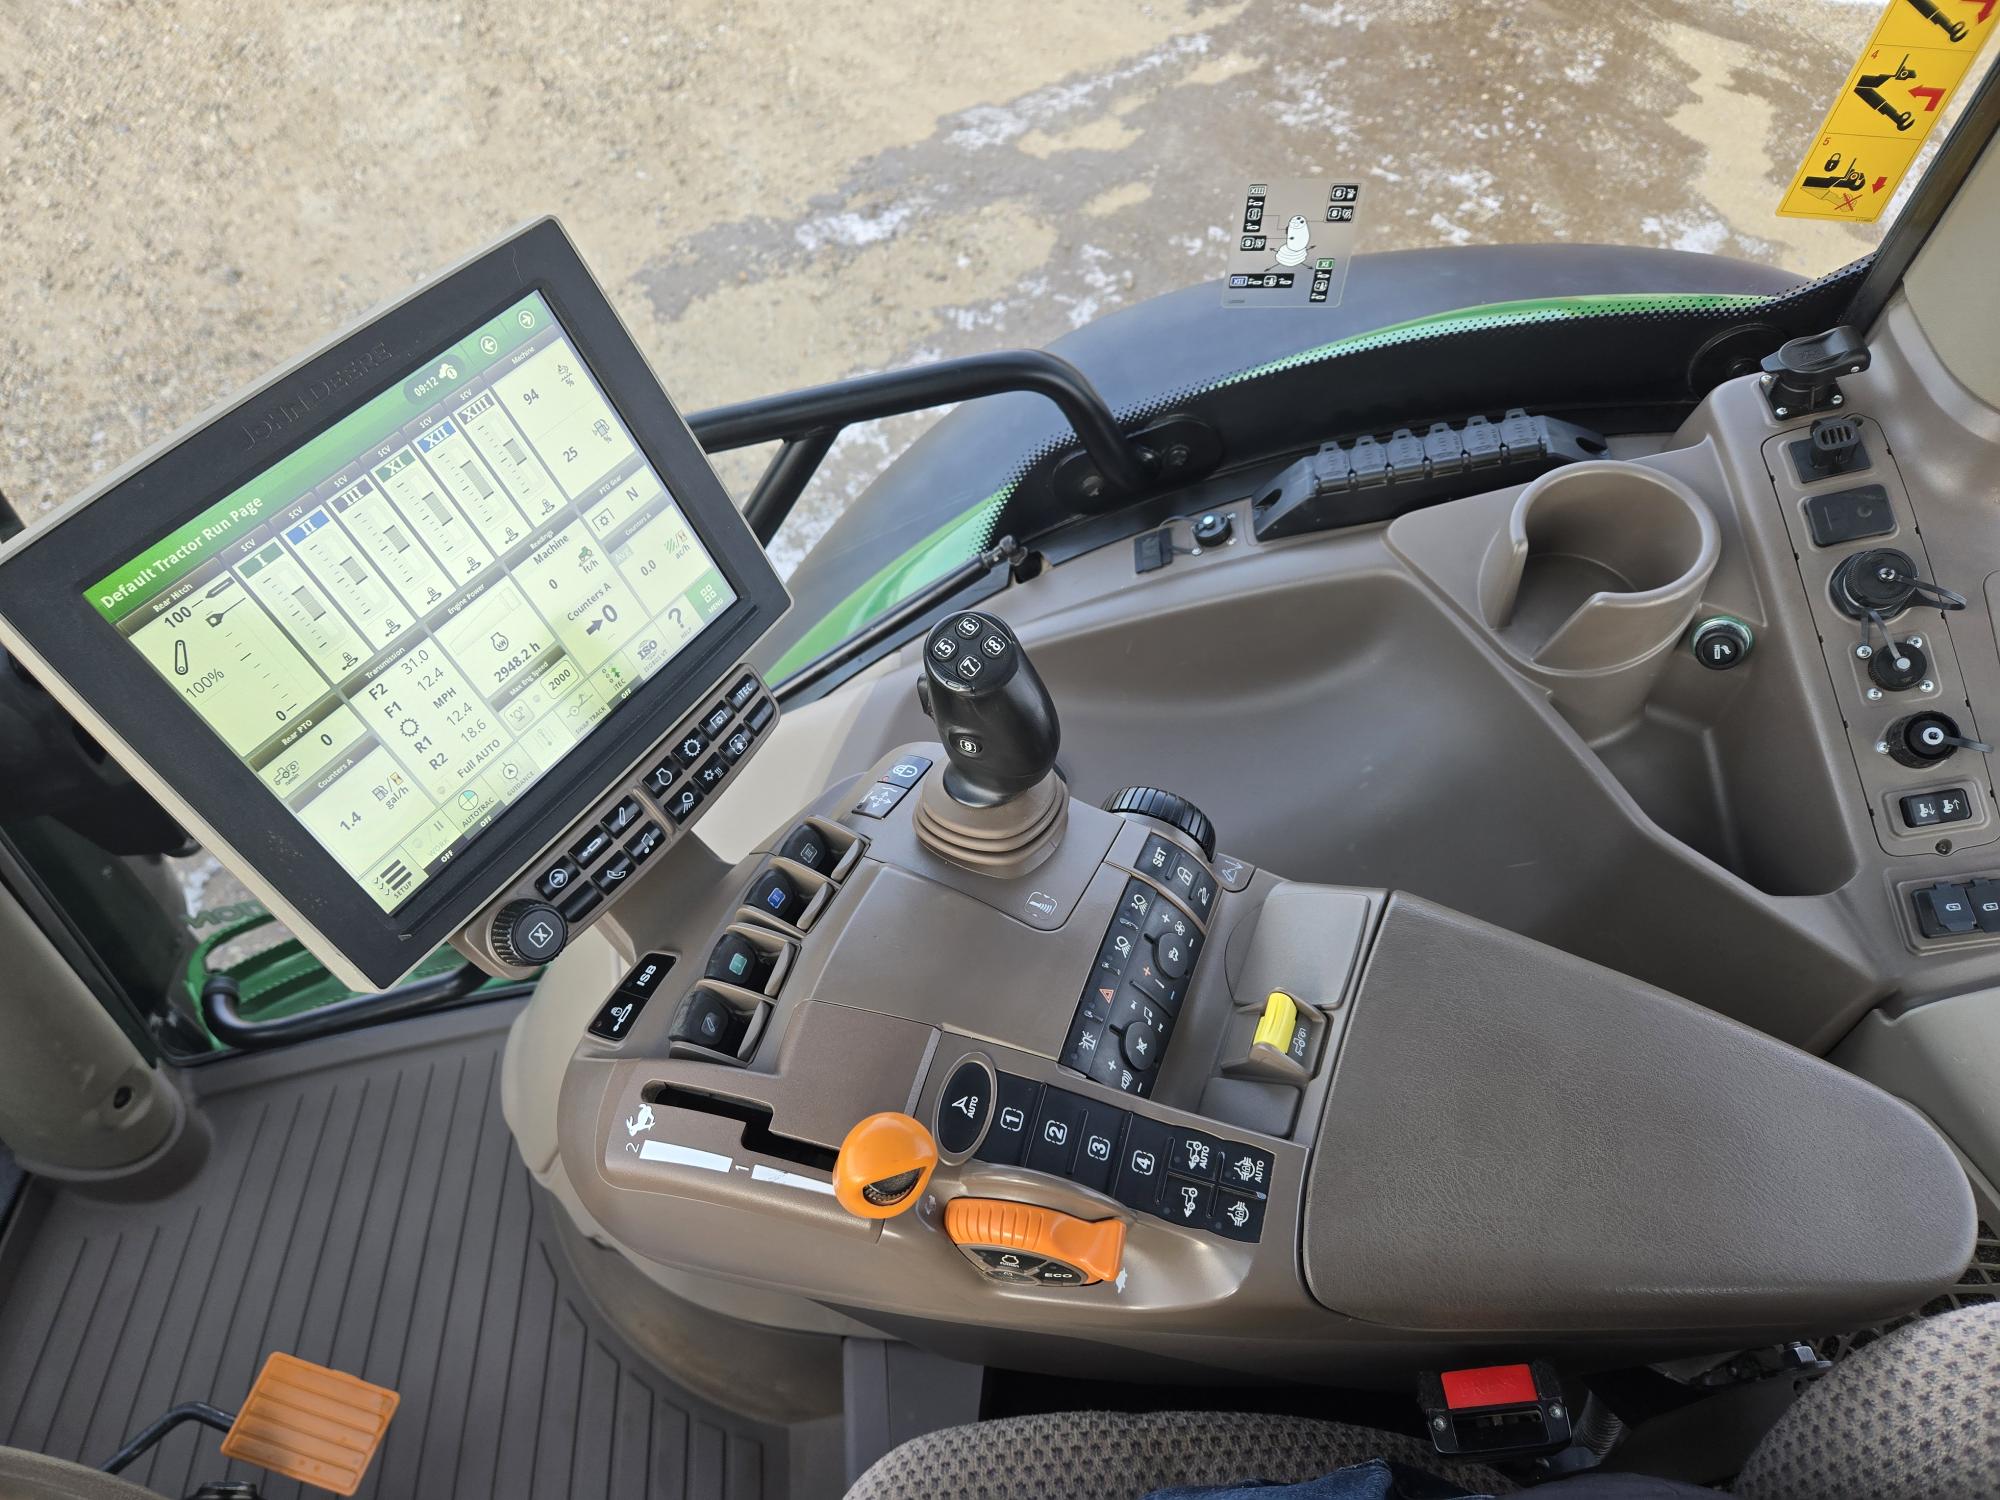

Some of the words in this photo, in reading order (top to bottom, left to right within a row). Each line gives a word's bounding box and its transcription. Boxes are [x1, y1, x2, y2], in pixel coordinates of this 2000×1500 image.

[1871, 50, 1880, 59] 4
[1823, 137, 1831, 146] 5
[308, 341, 393, 404] DEERE
[414, 377, 438, 397] 09:12
[523, 389, 540, 405] 94
[461, 395, 491, 422] XIII
[424, 426, 448, 449] XII
[563, 448, 578, 462] 25
[386, 457, 406, 476] XI
[341, 488, 363, 507] III
[626, 487, 639, 501] N
[300, 520, 316, 536] II
[100, 553, 155, 609] Default
[153, 532, 203, 573] Tractor
[203, 516, 229, 542] Run
[229, 496, 263, 526] Page
[533, 535, 569, 565] Machine
[257, 554, 268, 568] I
[640, 560, 656, 576] 0.0
[549, 579, 558, 590] 0
[153, 595, 171, 613] Rear
[171, 582, 194, 604] Hitch
[567, 590, 603, 621] Counters
[602, 582, 612, 592] A
[164, 606, 192, 629] 100
[602, 604, 618, 623] 0
[964, 620, 975, 631] 6
[939, 642, 951, 653] 5
[988, 640, 1001, 651] 8
[365, 647, 405, 679] Transmission
[494, 648, 533, 684] 2948.2
[530, 641, 540, 652] h
[964, 660, 977, 672] 7
[186, 668, 224, 698] 100%
[368, 683, 388, 701] F2
[401, 649, 429, 676] 31.0
[548, 668, 571, 690] 2000
[384, 701, 402, 719] F1
[417, 667, 444, 691] 12.4
[433, 687, 457, 709] MPH
[621, 688, 632, 699] OFF
[737, 683, 753, 701] iTEC
[276, 711, 286, 720] 0
[281, 731, 298, 746] Rear
[298, 720, 313, 734] PTO
[414, 735, 433, 754] R1
[446, 702, 473, 726] 12.4
[321, 734, 333, 746] 0
[429, 752, 448, 770] R2
[461, 719, 487, 743] 18.6
[457, 759, 476, 778] Full
[475, 739, 501, 764] AUTO
[317, 766, 346, 789] Counters
[386, 787, 409, 810] gal/h
[340, 811, 362, 831] 1.4
[462, 797, 494, 828] AUTOTRAC
[480, 815, 492, 827] OFF
[441, 850, 453, 863] OFF
[1153, 847, 1166, 867] SET
[393, 881, 412, 898] SETUP
[636, 965, 656, 986] ISB
[967, 1096, 978, 1119] AUTO
[1007, 1115, 1019, 1123] 1
[1050, 1127, 1063, 1139] 2
[626, 1142, 639, 1153] 2
[1092, 1142, 1105, 1154] 3
[1200, 1146, 1210, 1169] AUTO
[1136, 1156, 1150, 1169] 4
[1255, 1160, 1265, 1183] AUTO
